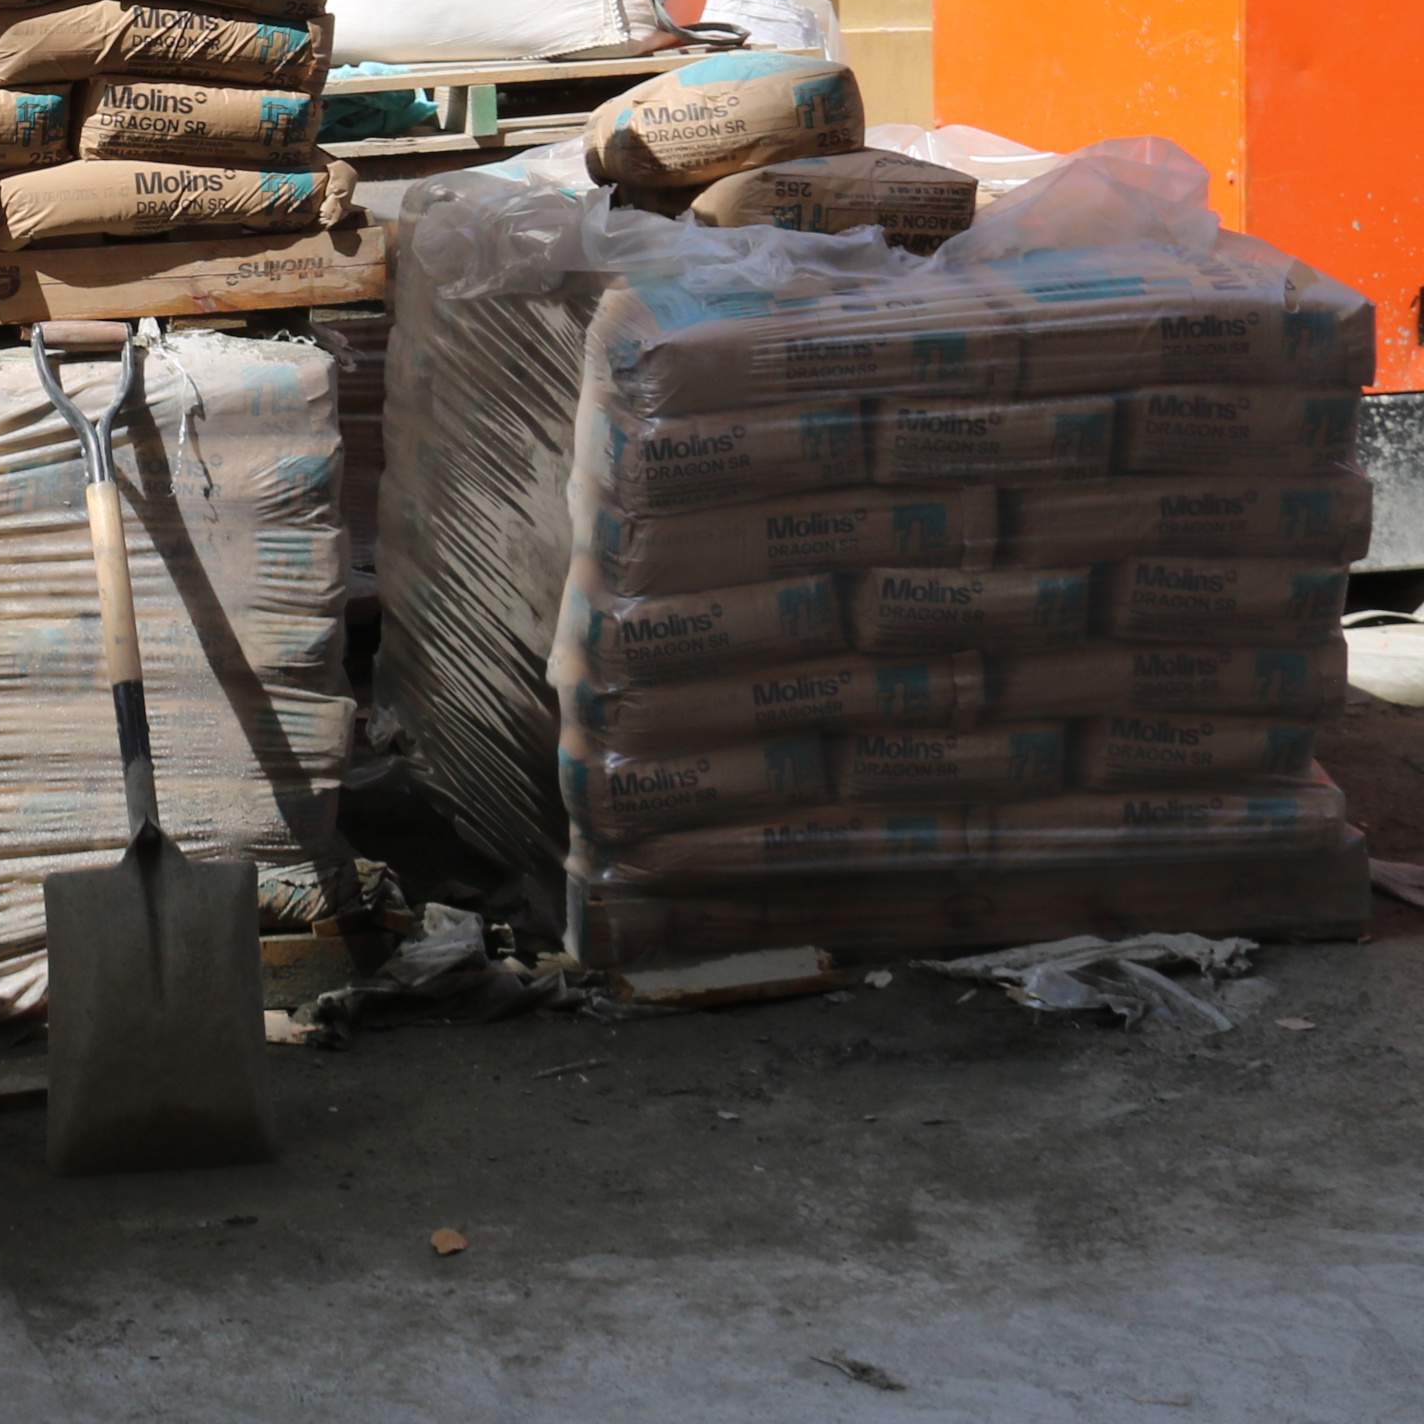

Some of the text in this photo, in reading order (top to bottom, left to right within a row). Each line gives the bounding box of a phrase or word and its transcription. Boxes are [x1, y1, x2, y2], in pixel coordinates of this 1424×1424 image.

[102, 83, 194, 115] Molins
[100, 113, 208, 135] DRAGON SR
[643, 102, 729, 127] Molins
[645, 119, 748, 144] DRAGON SR
[134, 170, 224, 195] Molins
[1159, 314, 1247, 338] Molins
[1149, 394, 1237, 420] Molins
[642, 432, 735, 463] Molins
[645, 460, 725, 481] DRAGON
[1160, 492, 1244, 519] Molins
[766, 512, 854, 540] Molins
[880, 577, 972, 604] Molins
[1136, 564, 1226, 593] Molins
[621, 613, 713, 644] Molins
[1135, 652, 1219, 676] Molins
[753, 674, 839, 706] Molins
[1107, 719, 1200, 744] Molins
[857, 735, 945, 760] Molins
[609, 766, 699, 797] Molins
